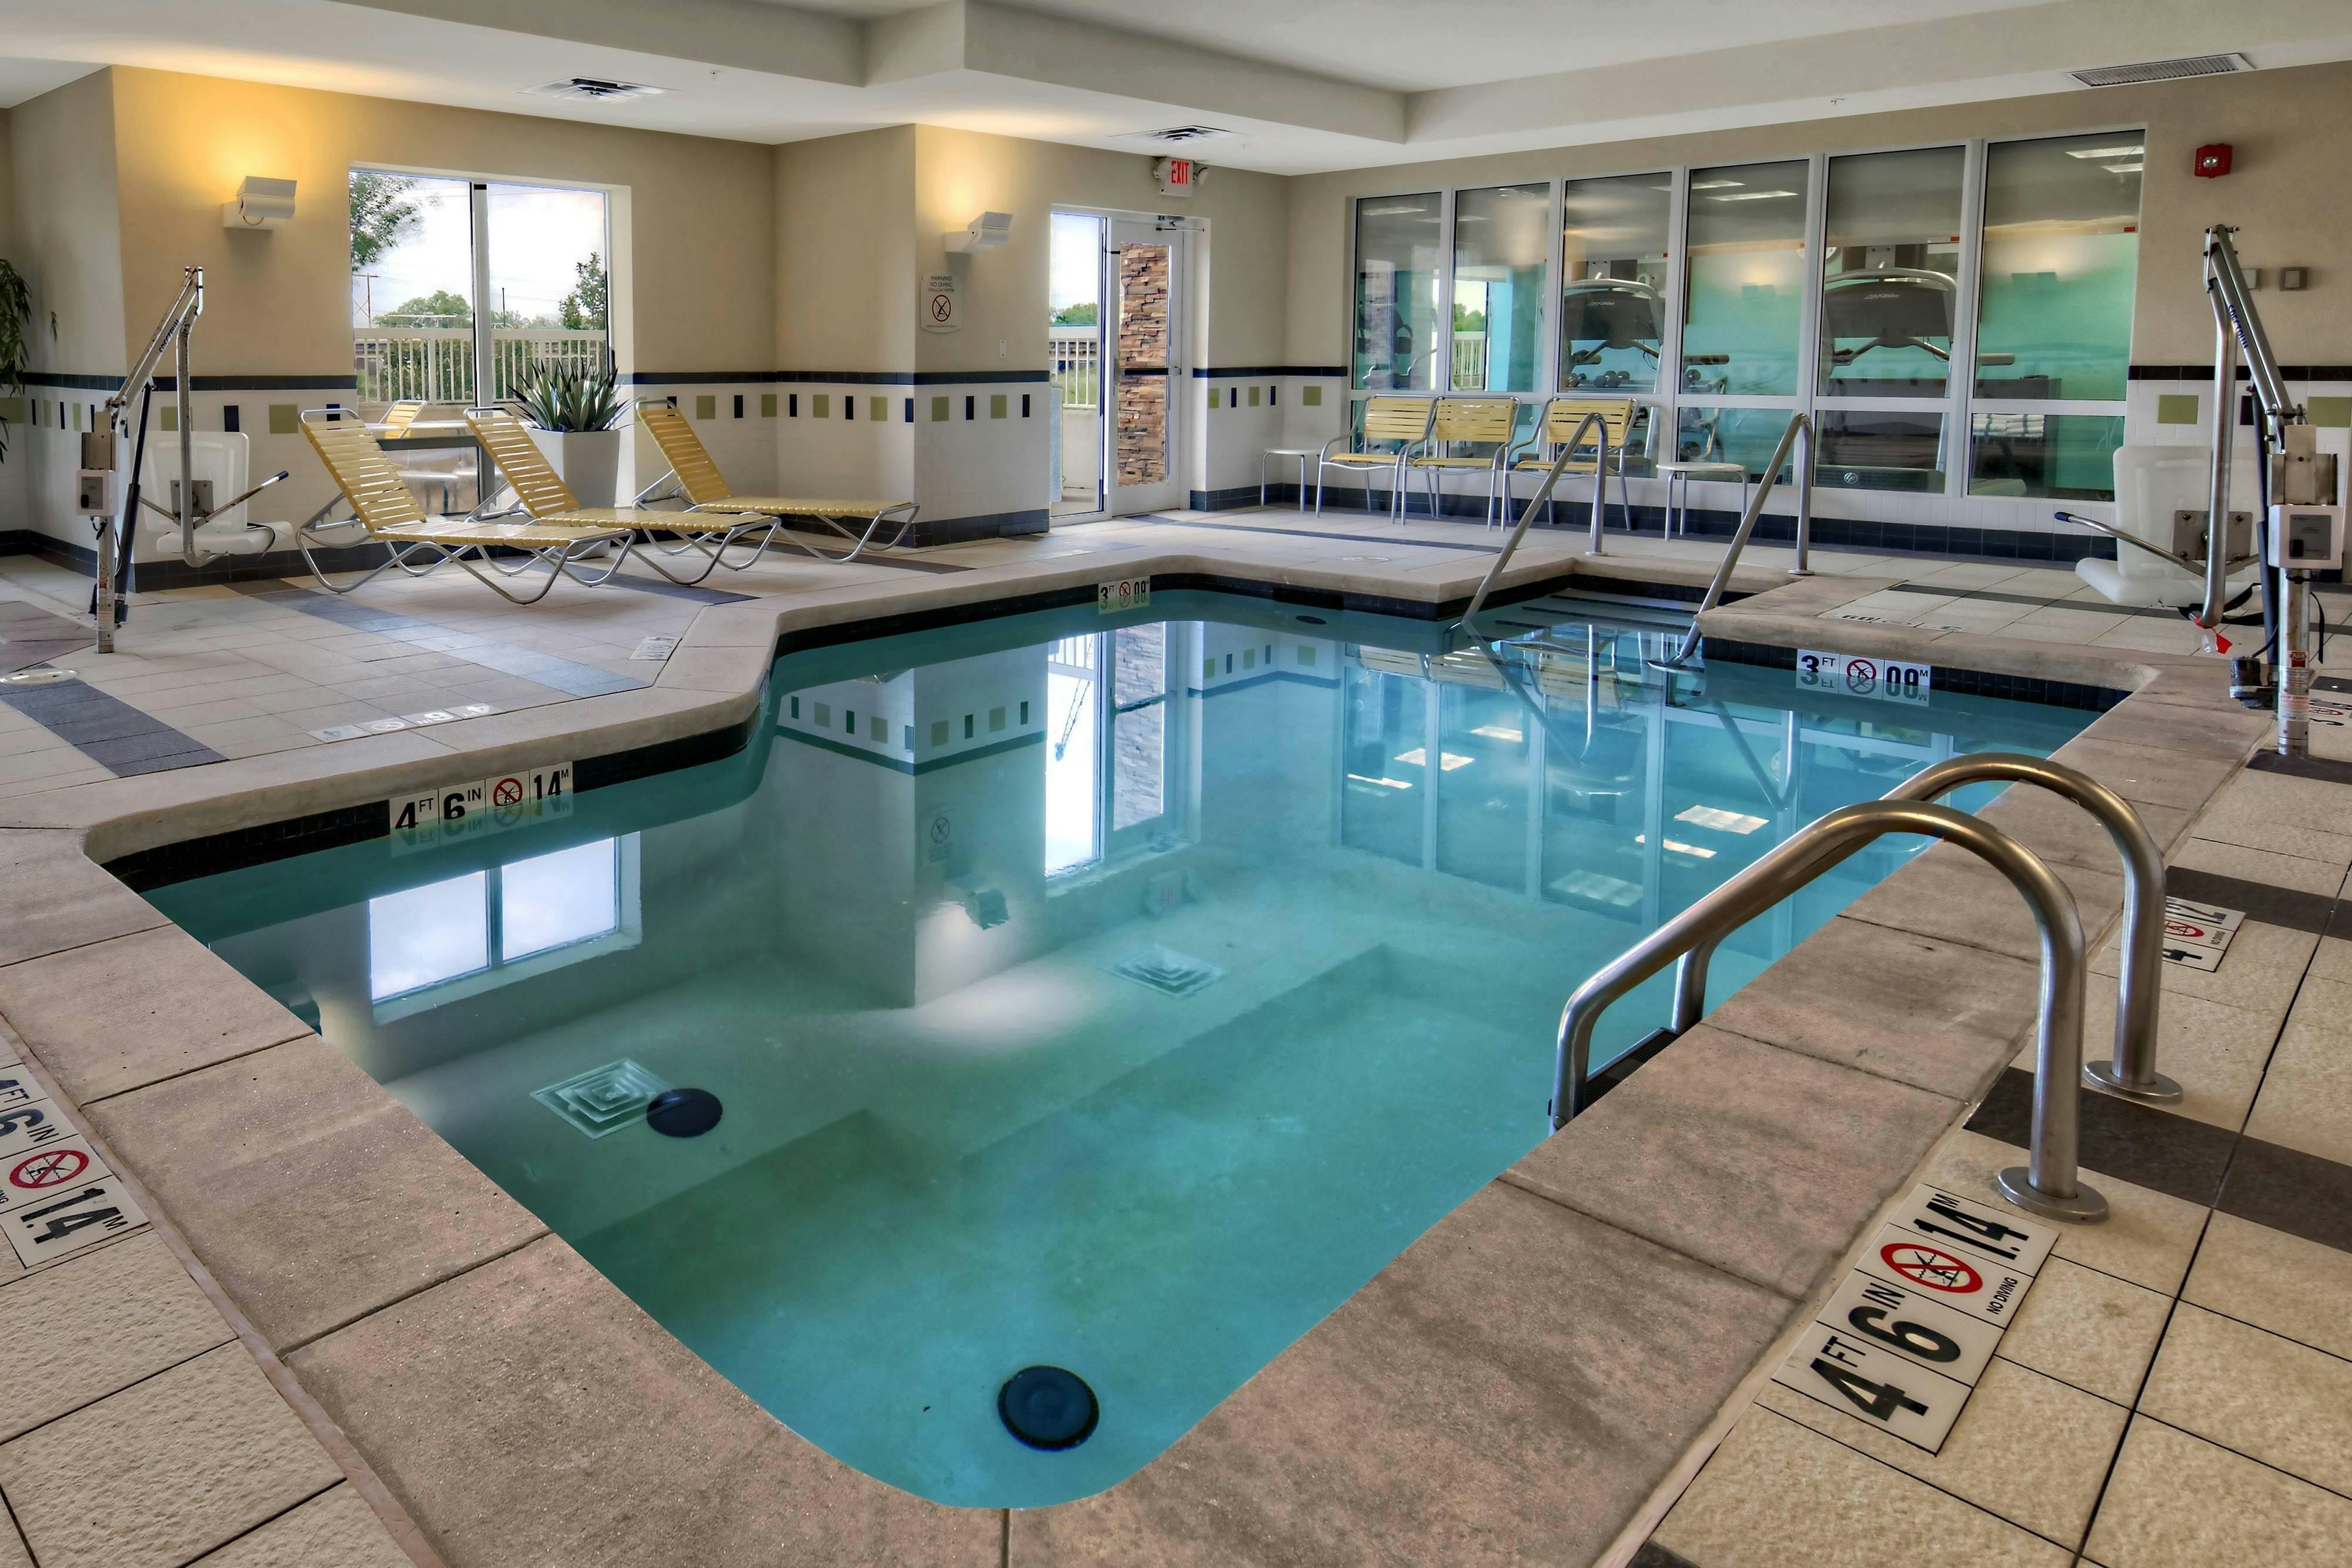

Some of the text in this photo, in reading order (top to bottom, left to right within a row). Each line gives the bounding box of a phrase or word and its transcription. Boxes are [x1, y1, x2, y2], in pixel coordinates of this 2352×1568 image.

[1171, 161, 1190, 184] EXIT
[443, 793, 465, 820] 6
[467, 787, 481, 802] IN
[26, 1125, 59, 1142] IN
[1862, 1282, 1905, 1309] IN
[1986, 1277, 2018, 1315] NO DIVING
[1848, 1306, 1961, 1362] 6
[1820, 1336, 1866, 1368] FT
[1810, 1357, 1929, 1422] 4
